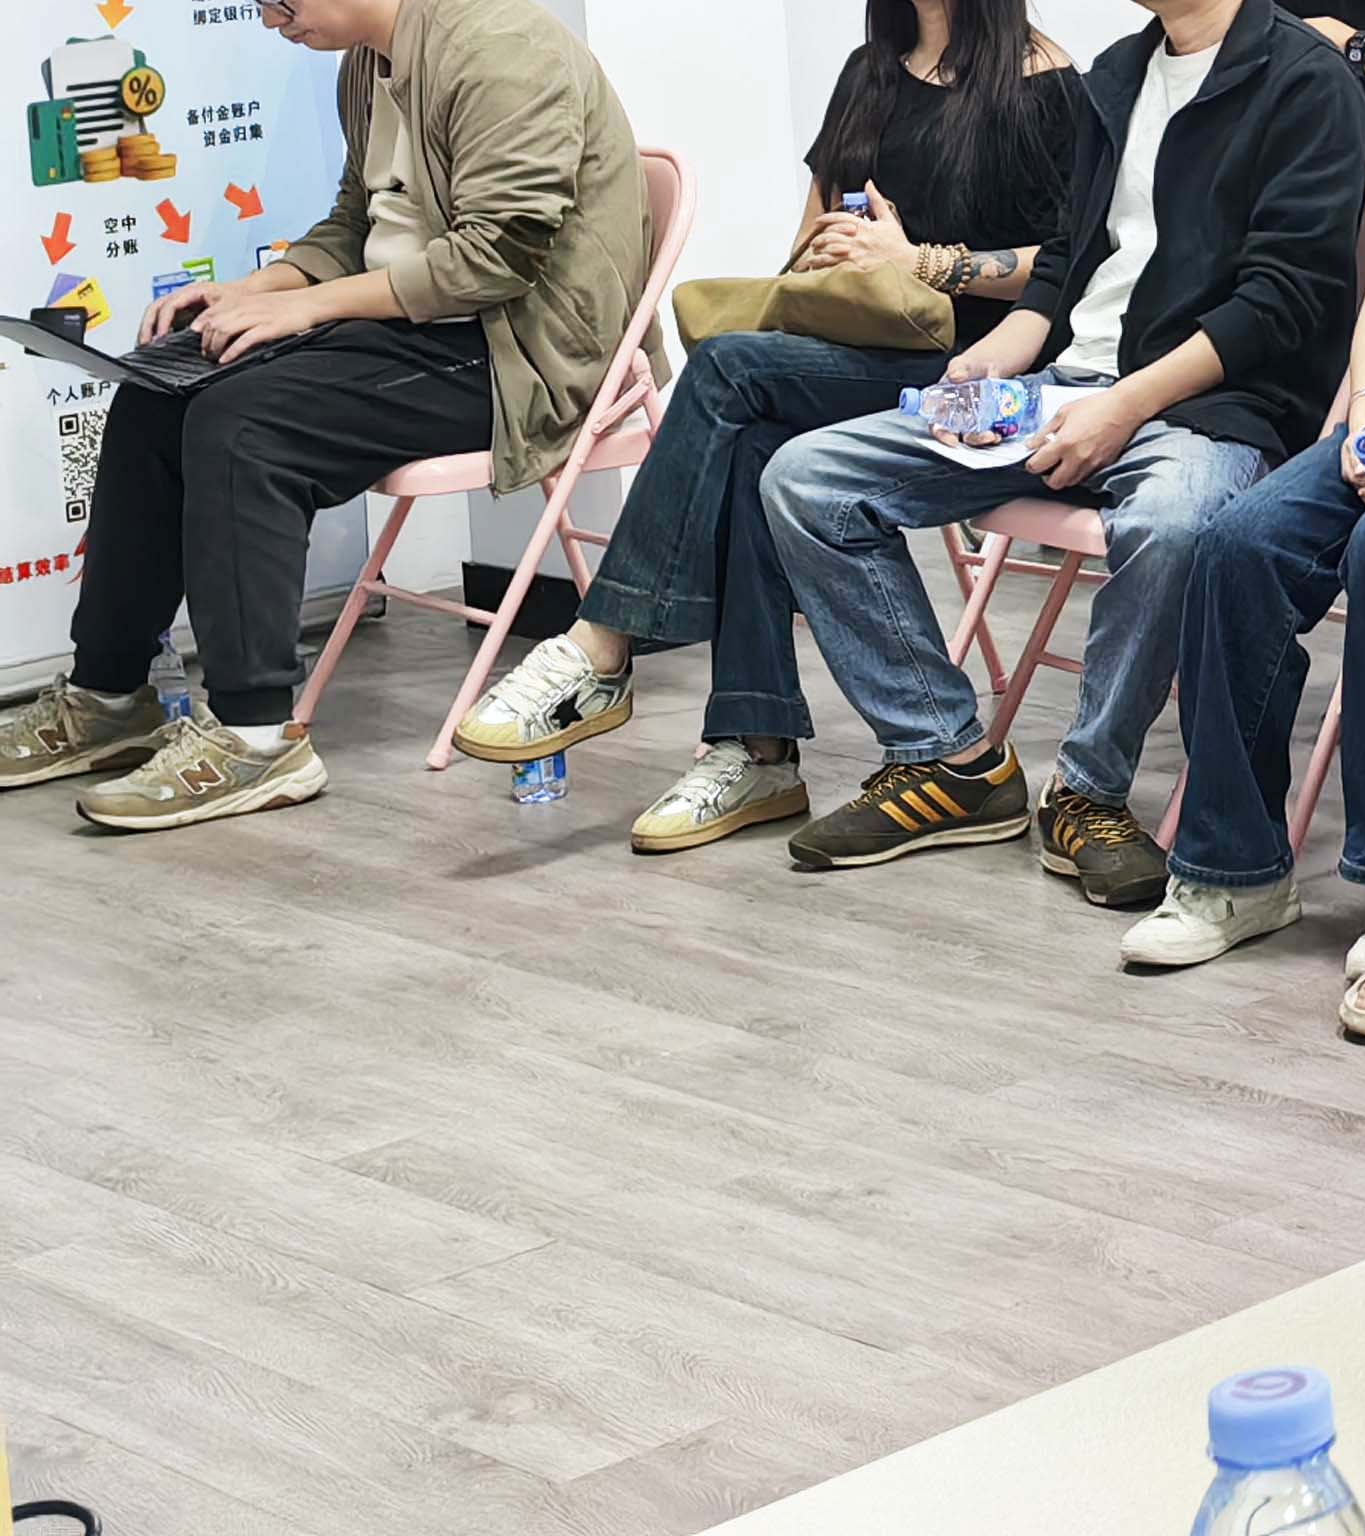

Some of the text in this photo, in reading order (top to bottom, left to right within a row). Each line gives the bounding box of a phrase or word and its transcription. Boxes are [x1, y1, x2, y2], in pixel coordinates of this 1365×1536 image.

[193, 4, 261, 25] 绑定银行
[187, 101, 261, 126] 备付金账户
[203, 124, 264, 148] 资金归集
[104, 215, 137, 234] 空中
[106, 238, 139, 258] 分账
[47, 380, 112, 406] 个人账户
